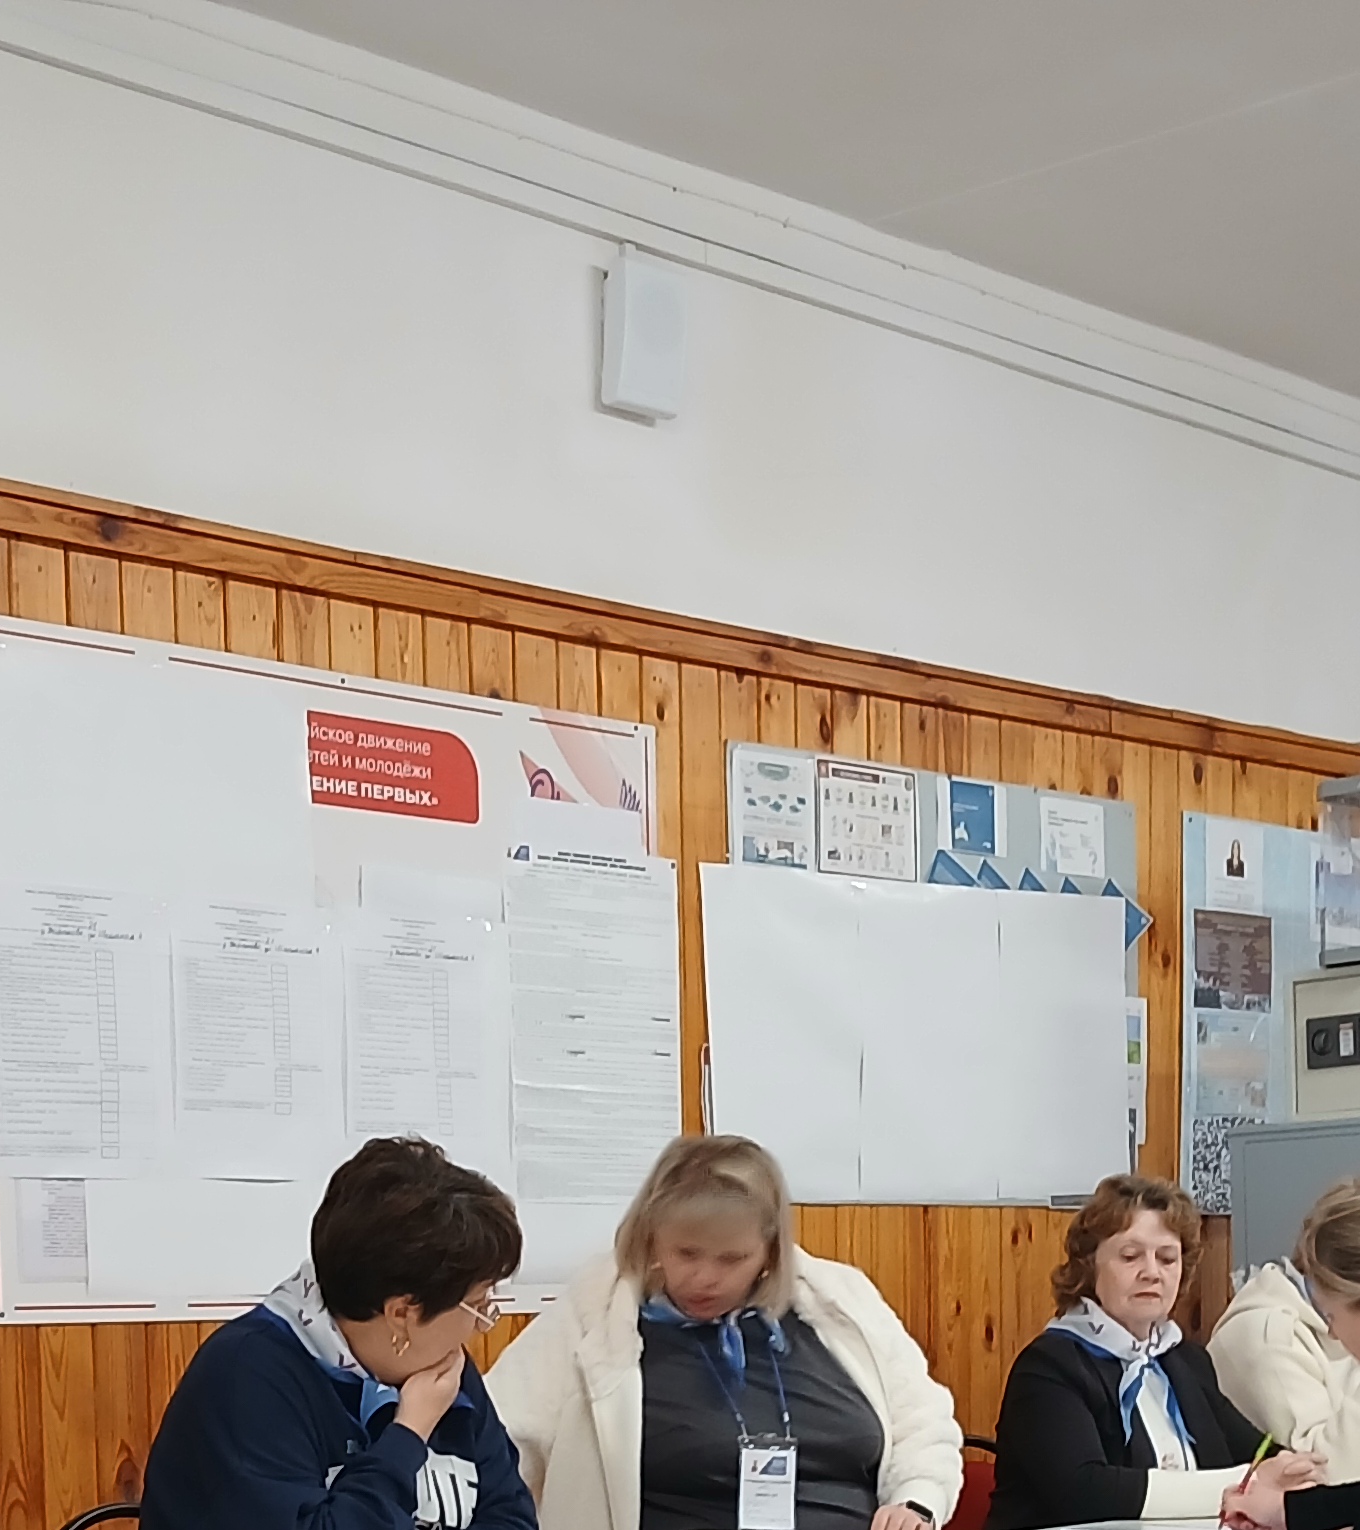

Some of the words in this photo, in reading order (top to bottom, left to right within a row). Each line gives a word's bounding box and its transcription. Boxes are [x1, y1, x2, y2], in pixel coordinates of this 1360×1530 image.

[356, 732, 432, 757] движение
[342, 754, 352, 769] и
[355, 756, 432, 780] молодёжи
[312, 776, 359, 796] ЕНИЕ
